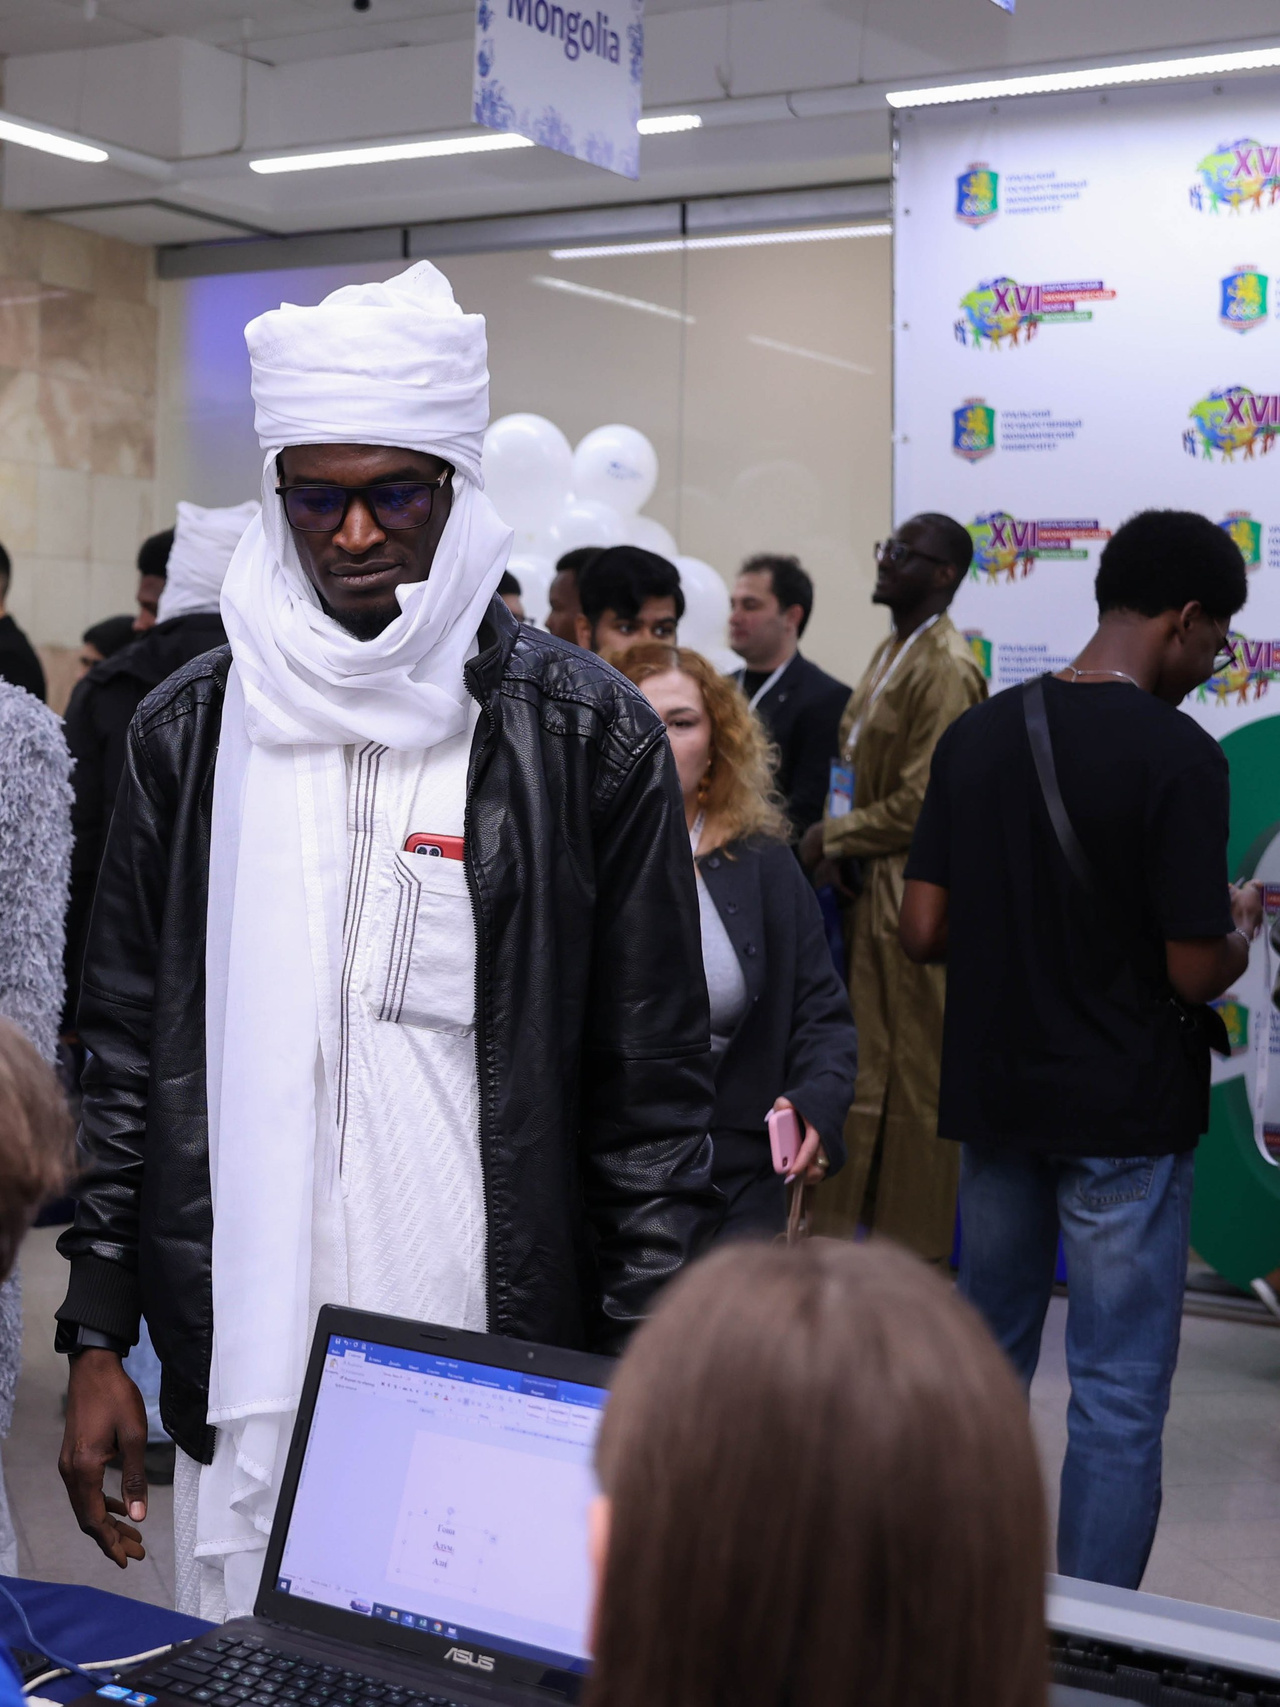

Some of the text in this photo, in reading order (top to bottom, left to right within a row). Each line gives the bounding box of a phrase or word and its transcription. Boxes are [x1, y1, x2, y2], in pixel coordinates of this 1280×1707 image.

[991, 285, 1041, 315] XVI
[988, 520, 1037, 549] XVI
[443, 1646, 496, 1672] ASUS
